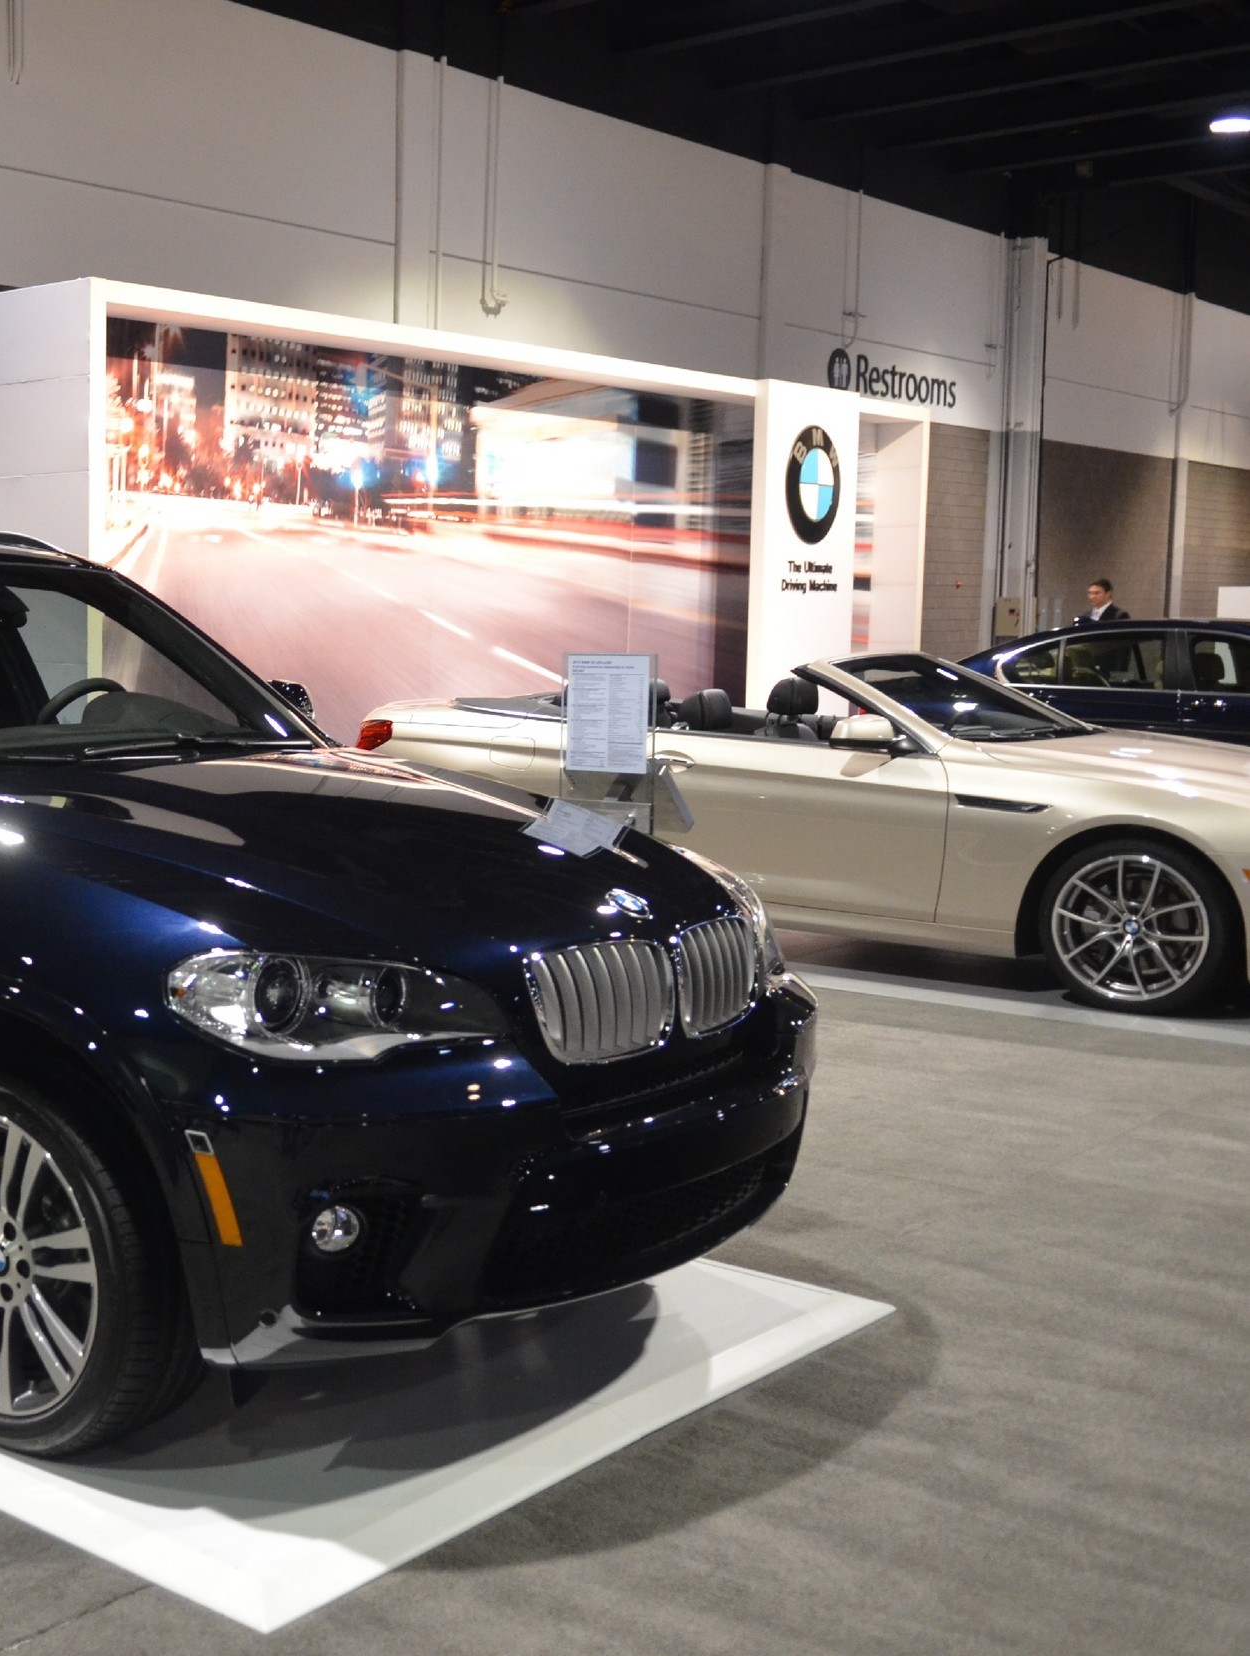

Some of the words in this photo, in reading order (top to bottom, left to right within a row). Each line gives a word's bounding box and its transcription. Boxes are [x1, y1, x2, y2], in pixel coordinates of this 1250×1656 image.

[855, 354, 956, 408] Restrooms
[792, 427, 839, 468] BMW
[788, 560, 801, 573] The
[804, 560, 833, 574] Ultimate
[781, 578, 807, 594] Driving
[809, 579, 838, 592] Machine
